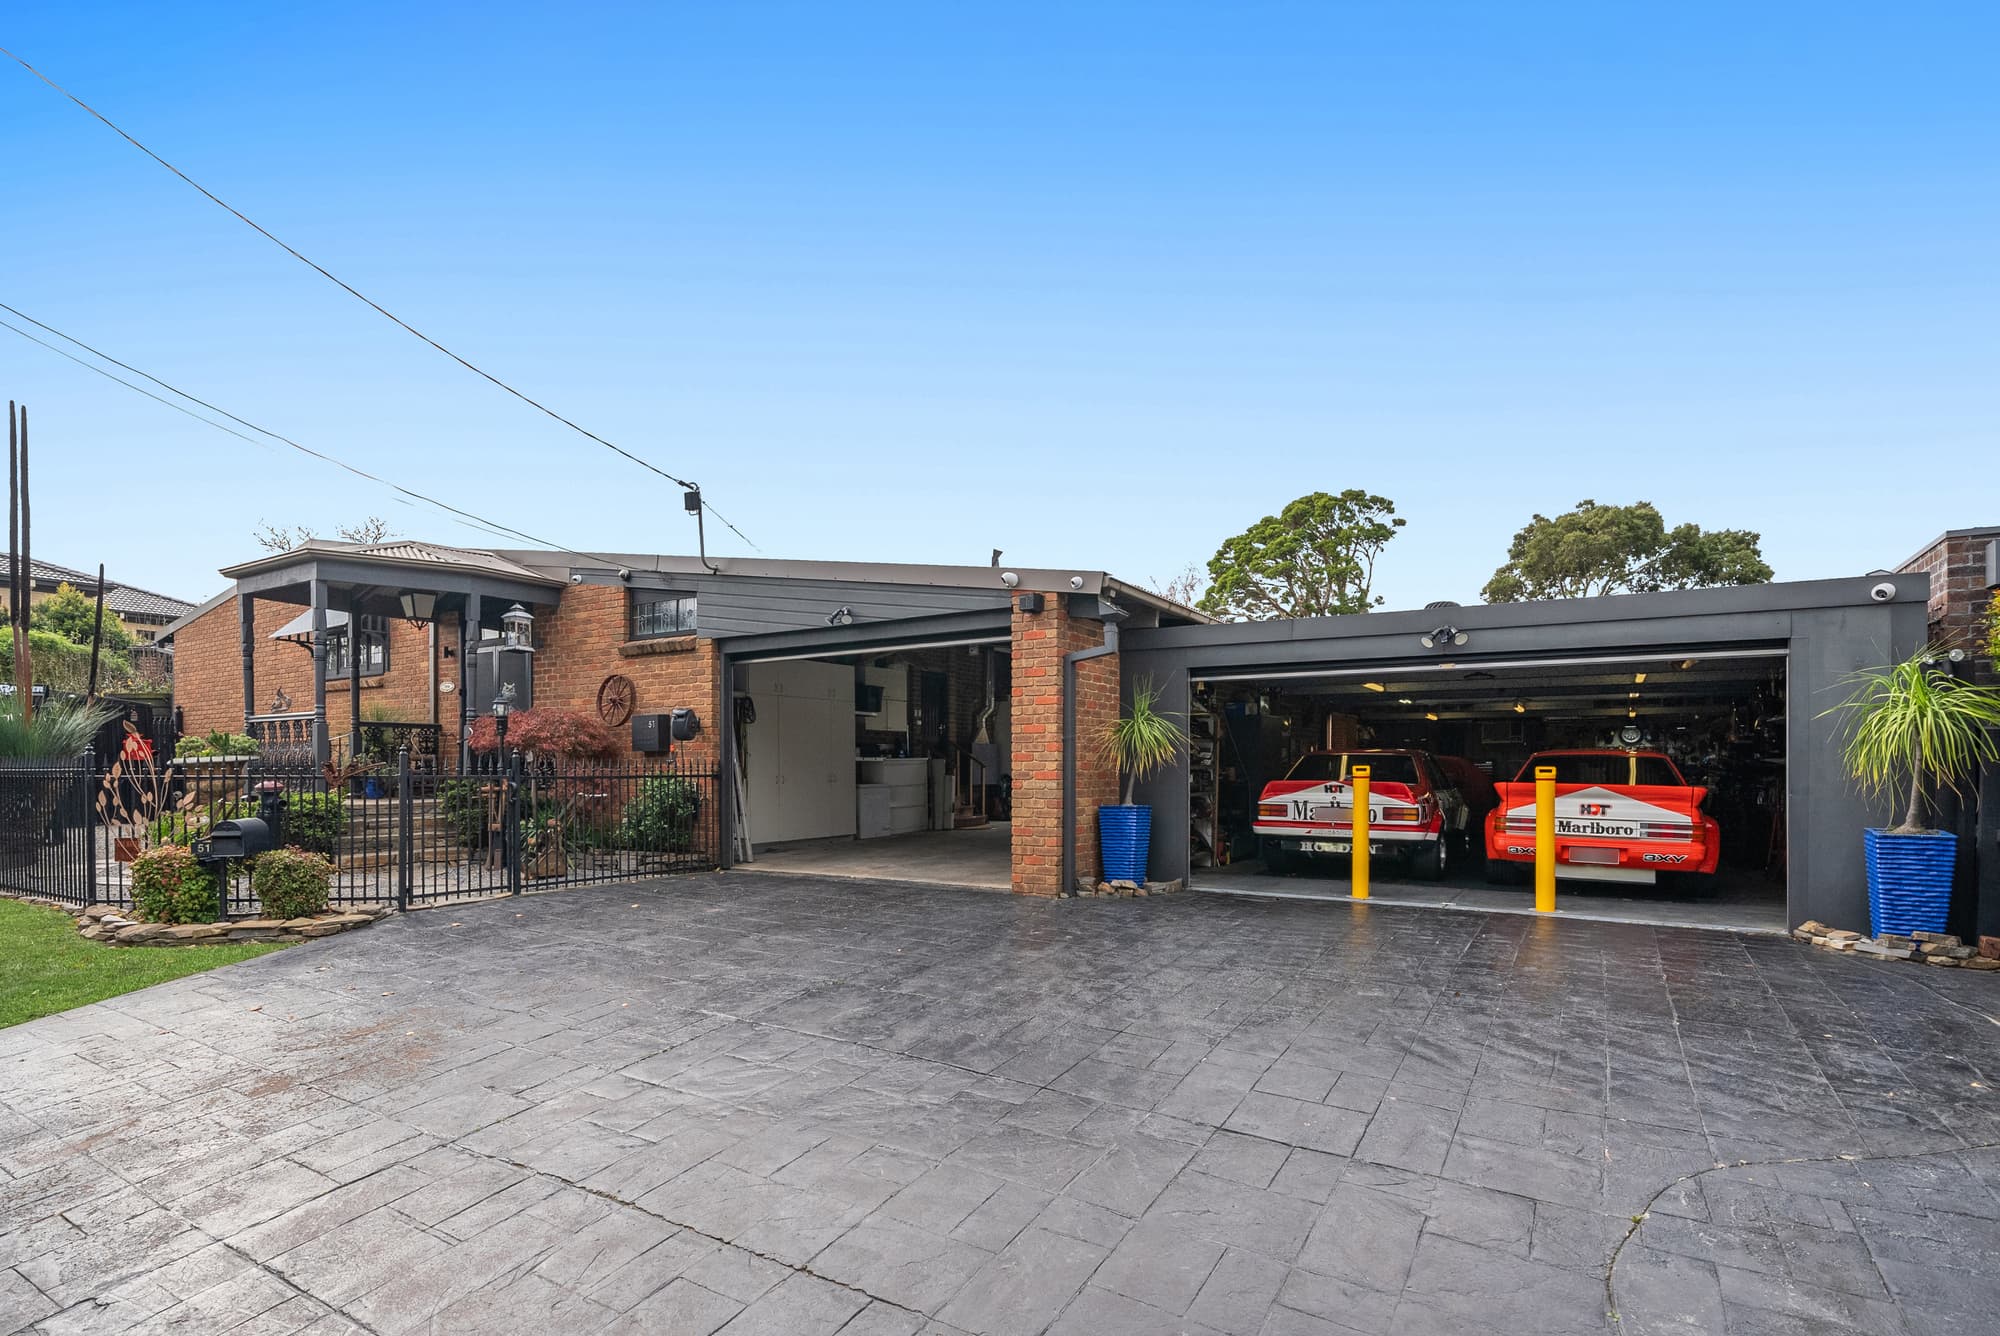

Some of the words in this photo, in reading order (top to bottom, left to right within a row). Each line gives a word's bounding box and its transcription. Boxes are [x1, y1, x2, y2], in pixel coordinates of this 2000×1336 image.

[1557, 820, 1634, 836] Marlboro
[197, 844, 211, 853] 51
[1508, 846, 1537, 856] 3X
